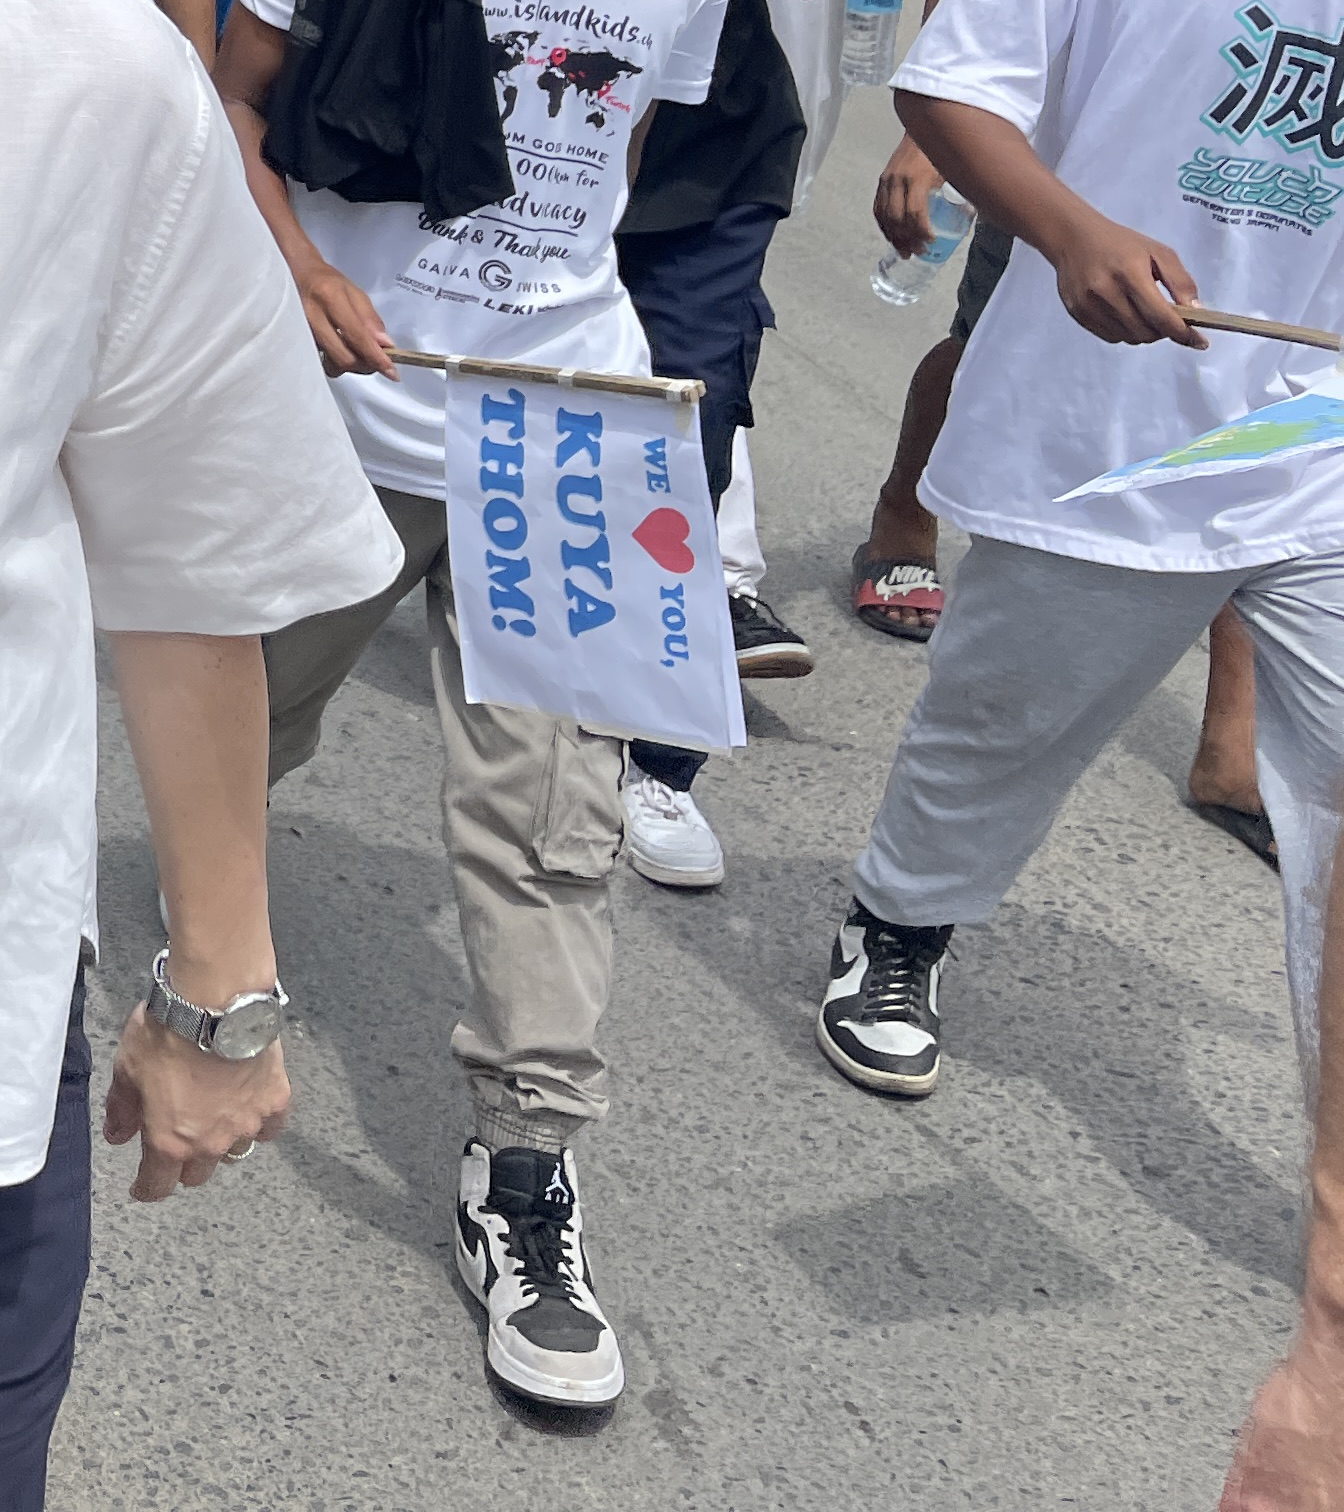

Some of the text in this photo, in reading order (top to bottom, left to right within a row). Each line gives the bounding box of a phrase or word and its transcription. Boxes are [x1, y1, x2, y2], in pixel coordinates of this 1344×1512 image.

[566, 143, 609, 165] HOME
[576, 169, 599, 189] for
[483, 297, 534, 315] LEKI
[480, 388, 537, 639] THOM!
[555, 406, 617, 639] KUYA
[643, 437, 690, 669] WE YOU,
